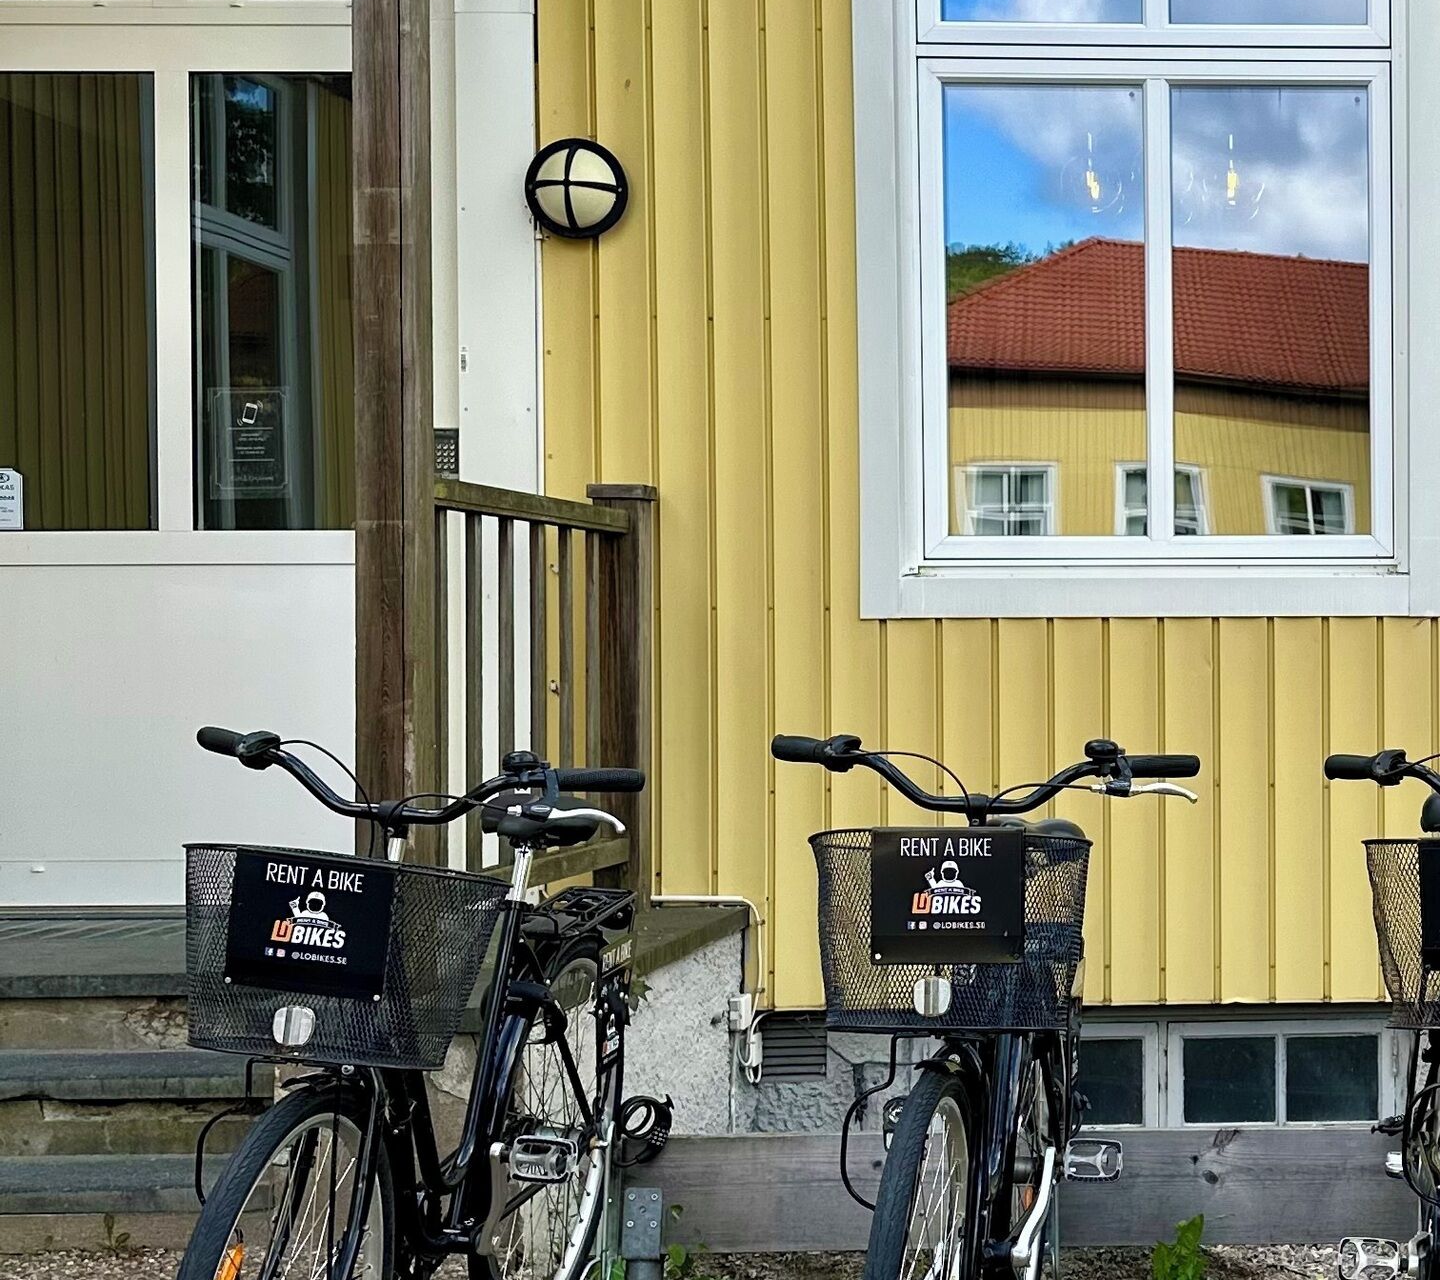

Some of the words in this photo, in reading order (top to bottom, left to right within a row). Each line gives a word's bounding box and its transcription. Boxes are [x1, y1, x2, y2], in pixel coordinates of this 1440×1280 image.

[900, 837, 939, 856] RENT
[943, 838, 955, 856] A
[959, 837, 992, 856] BIKE
[266, 862, 309, 886] RENT
[311, 868, 324, 888] A
[328, 870, 365, 893] BIKE
